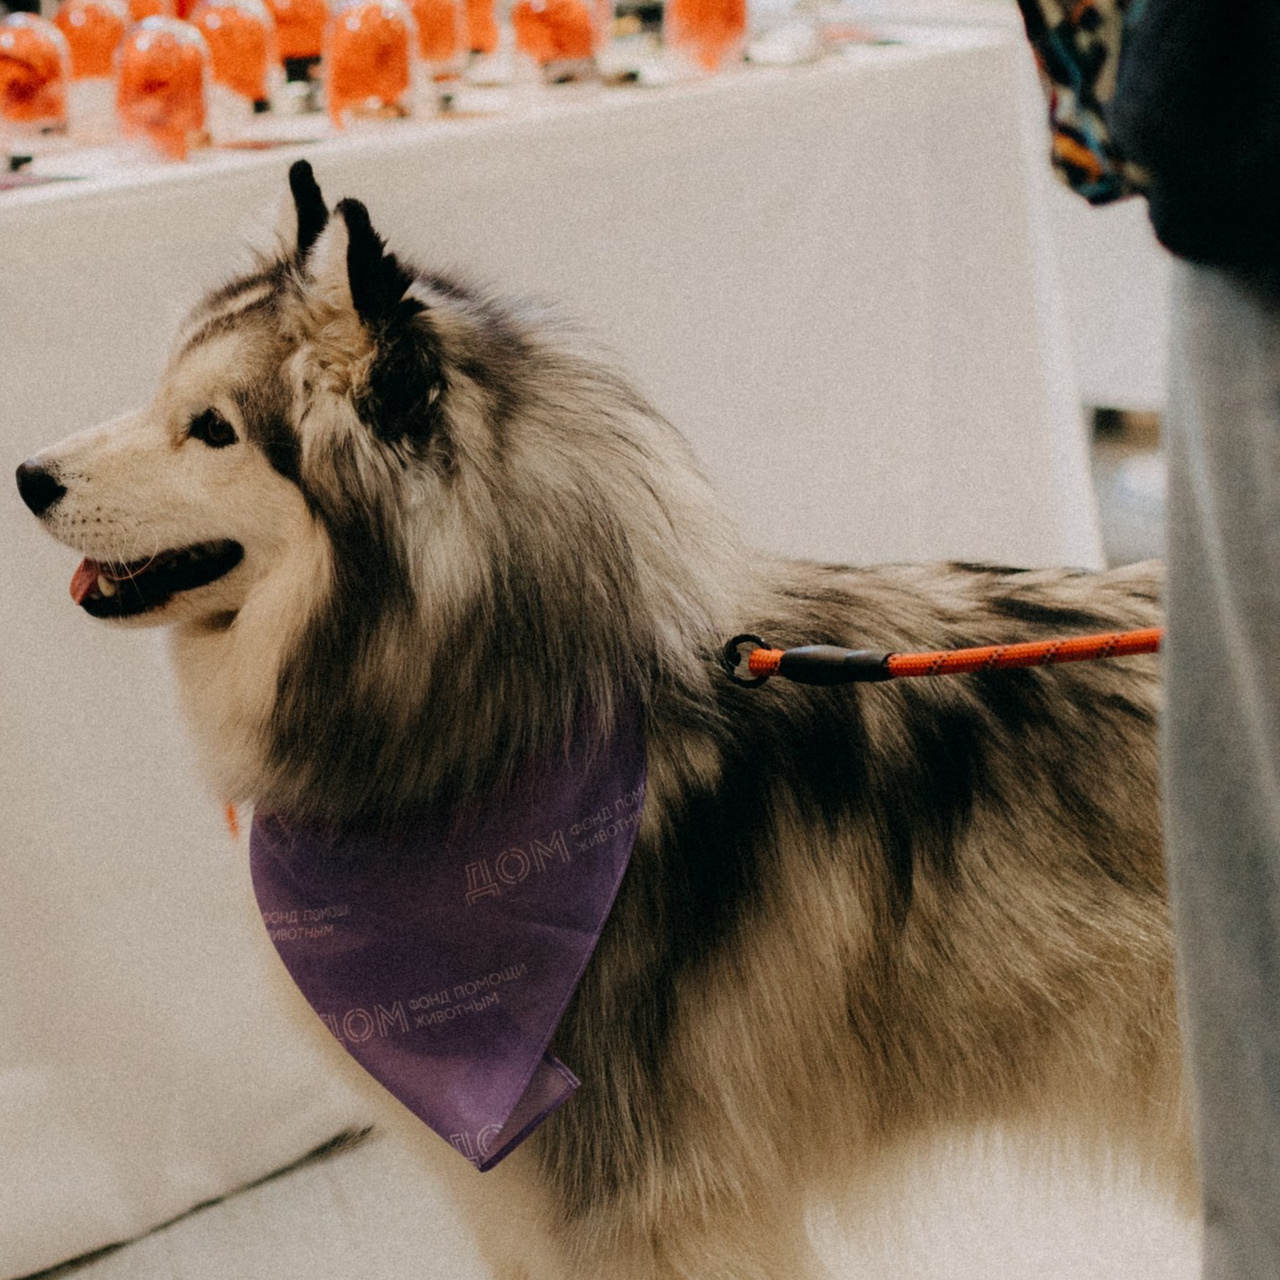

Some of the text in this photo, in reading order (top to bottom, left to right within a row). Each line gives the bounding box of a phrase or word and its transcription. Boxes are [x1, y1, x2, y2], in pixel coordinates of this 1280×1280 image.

[569, 807, 613, 836] ФОНД
[464, 829, 571, 907] ДОМ
[408, 962, 528, 1011] ФОНД ПОМОЩИ
[413, 991, 501, 1029] ЖИВОТНЫМ
